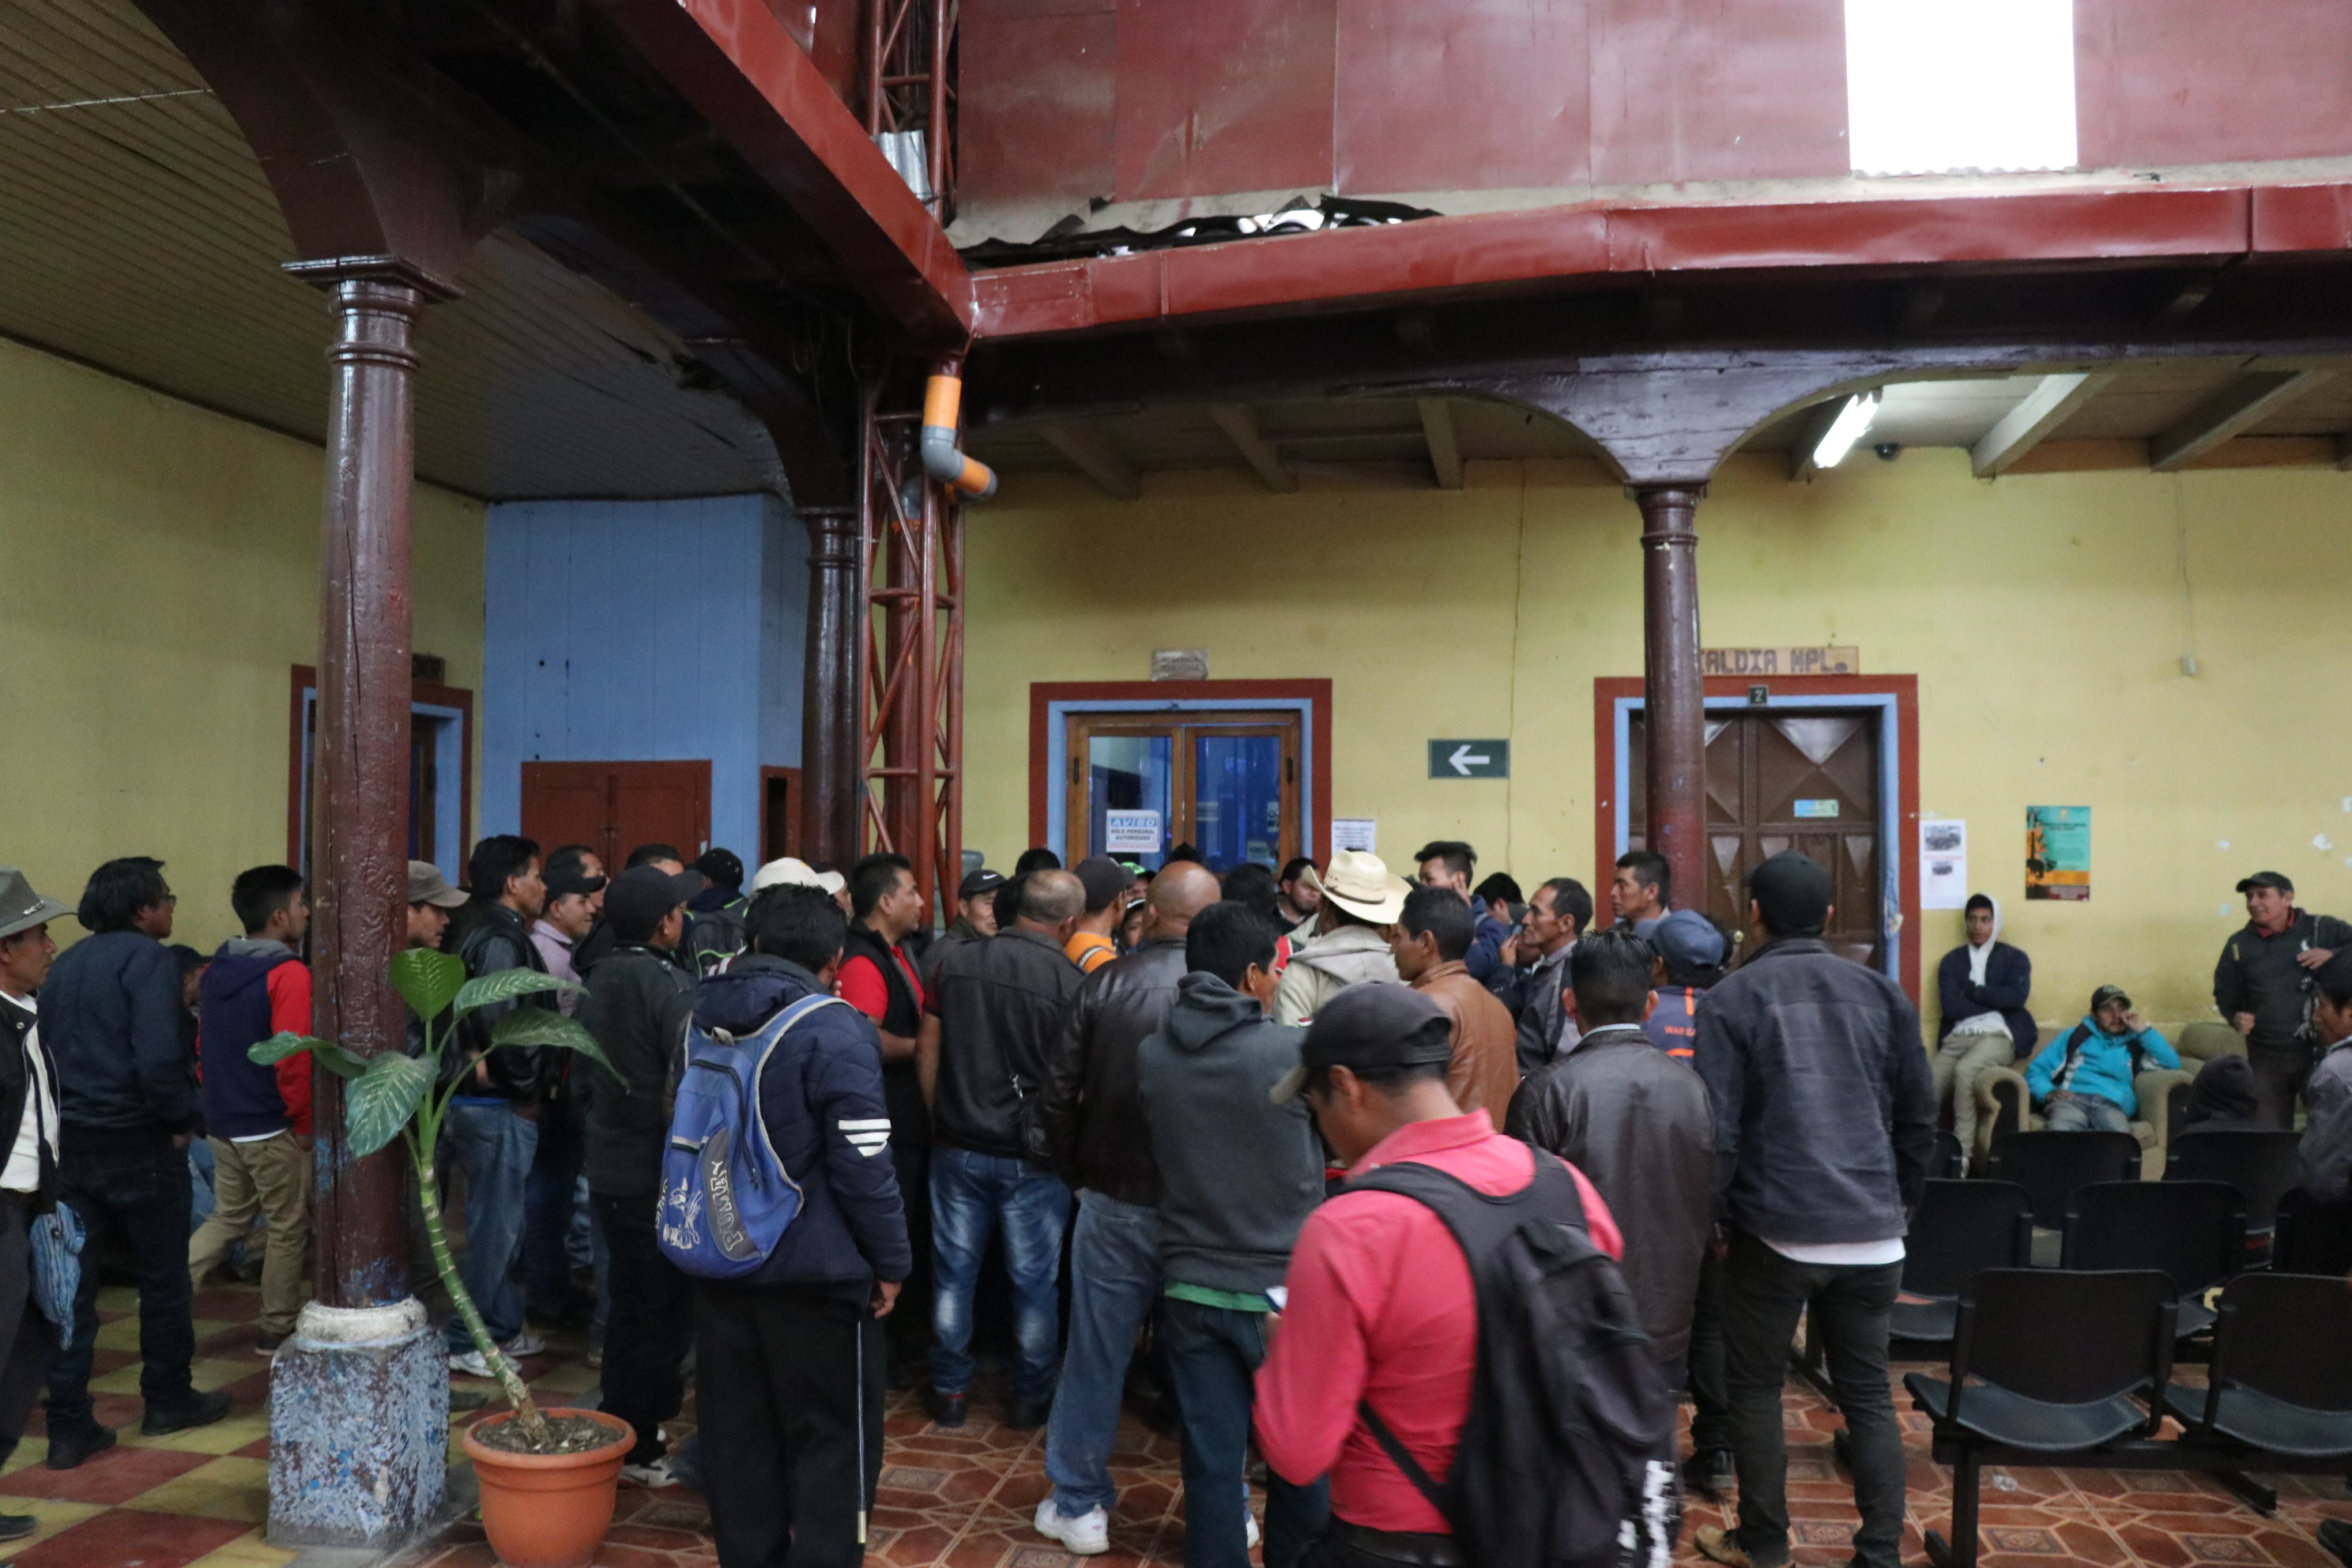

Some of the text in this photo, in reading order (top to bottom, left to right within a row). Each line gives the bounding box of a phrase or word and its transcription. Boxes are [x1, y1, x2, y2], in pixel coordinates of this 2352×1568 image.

[1754, 688, 1764, 703] 2
[1110, 818, 1157, 827] AVISO
[710, 1170, 744, 1252] PUMA
